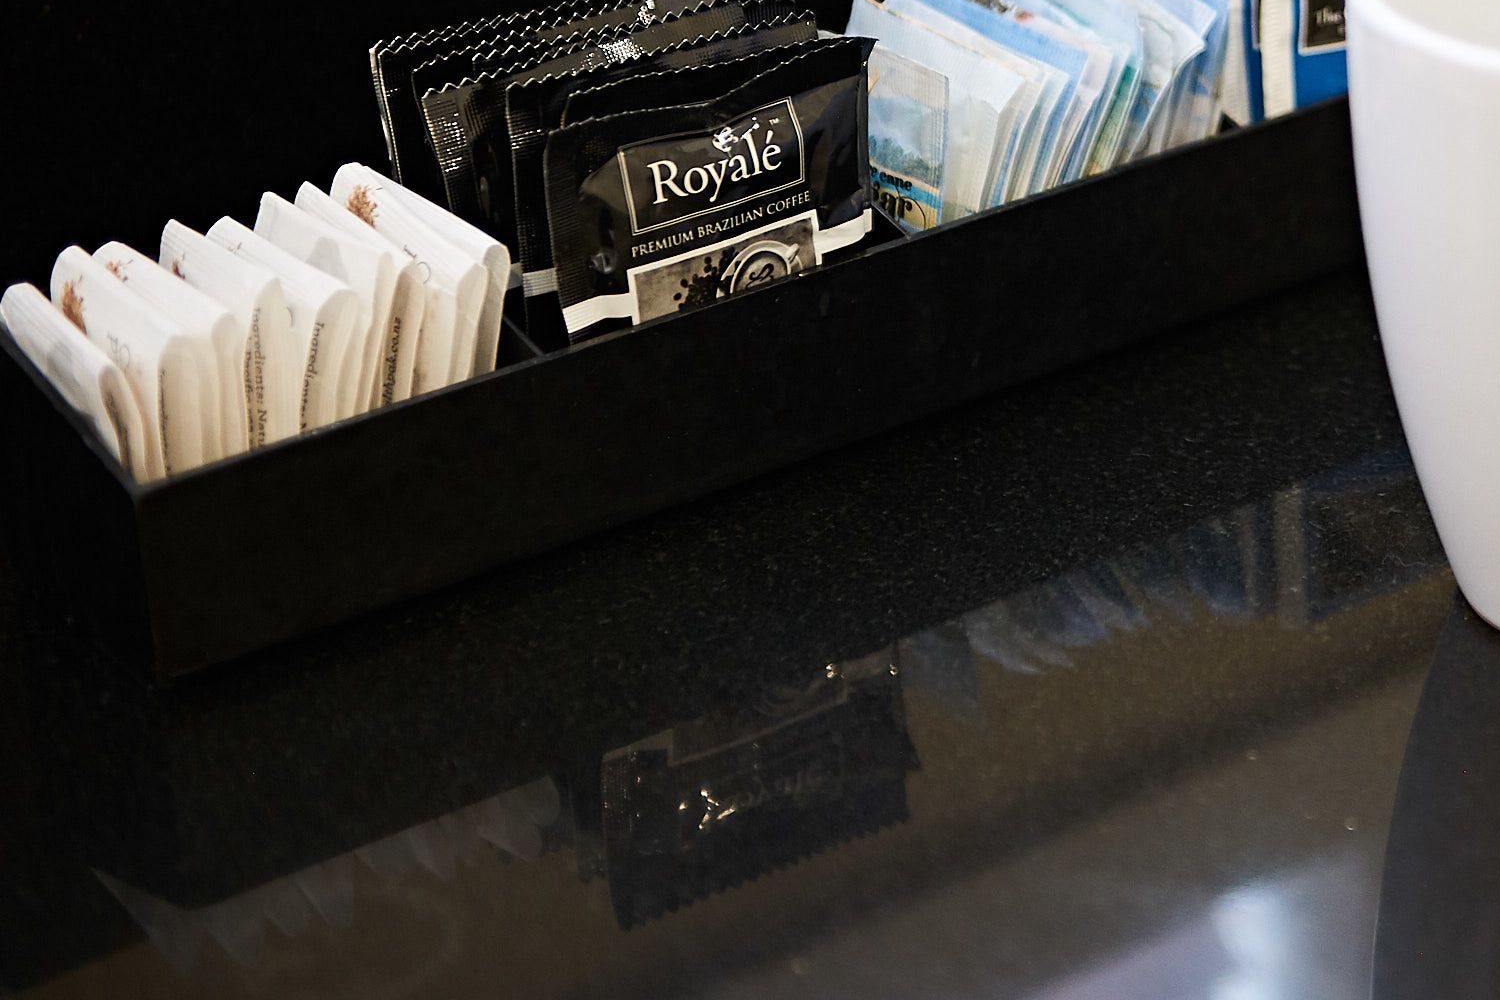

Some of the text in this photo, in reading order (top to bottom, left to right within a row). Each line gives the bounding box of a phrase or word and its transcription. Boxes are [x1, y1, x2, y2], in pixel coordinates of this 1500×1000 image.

[646, 130, 782, 204] Royalé
[631, 190, 811, 259] PREMIUM BRAZILIAN COFFEE
